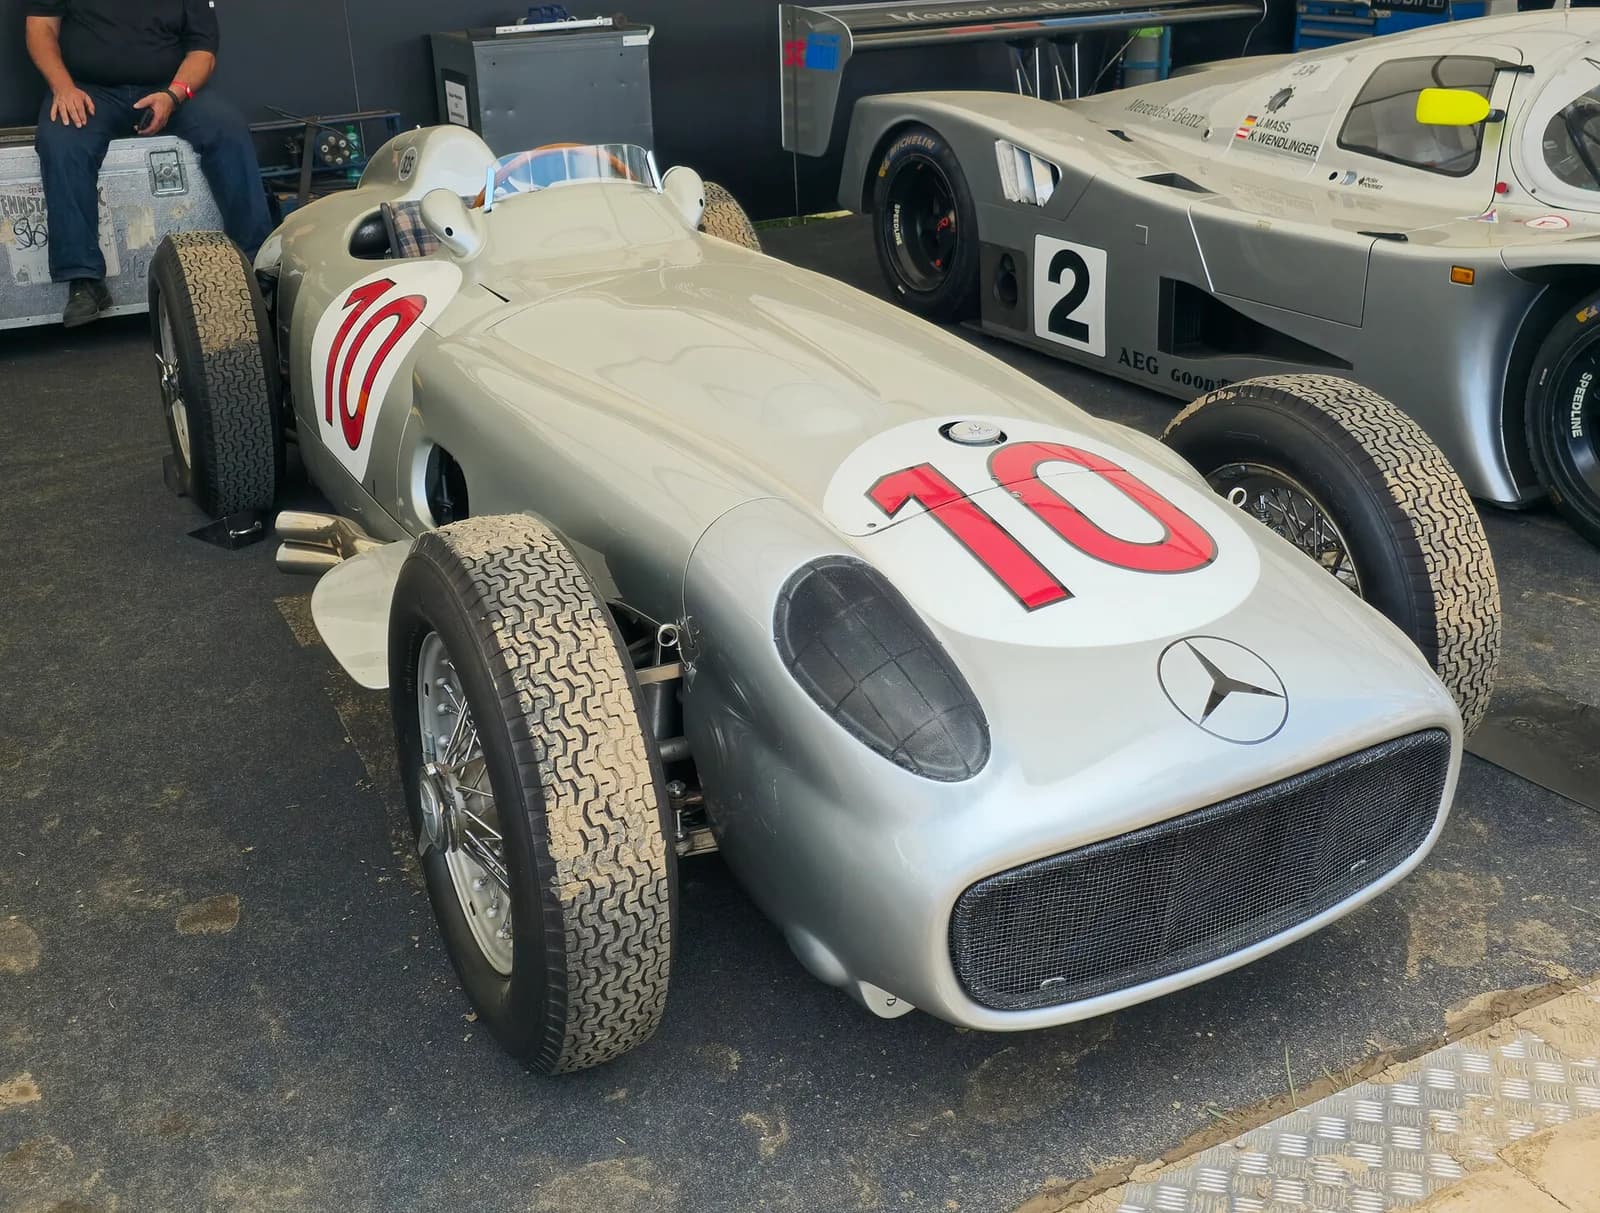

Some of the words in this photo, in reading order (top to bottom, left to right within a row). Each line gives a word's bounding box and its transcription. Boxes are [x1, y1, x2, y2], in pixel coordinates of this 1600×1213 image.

[1125, 98, 1205, 128] Mercedes-Benz
[890, 135, 935, 157] MICHELIN
[893, 204, 903, 246] SPEEDLINE
[1047, 249, 1090, 344] 2
[325, 278, 427, 450] 10
[1118, 347, 1159, 375] AEG
[1571, 372, 1592, 438] SPEEDLINE
[864, 441, 1219, 613] 10
